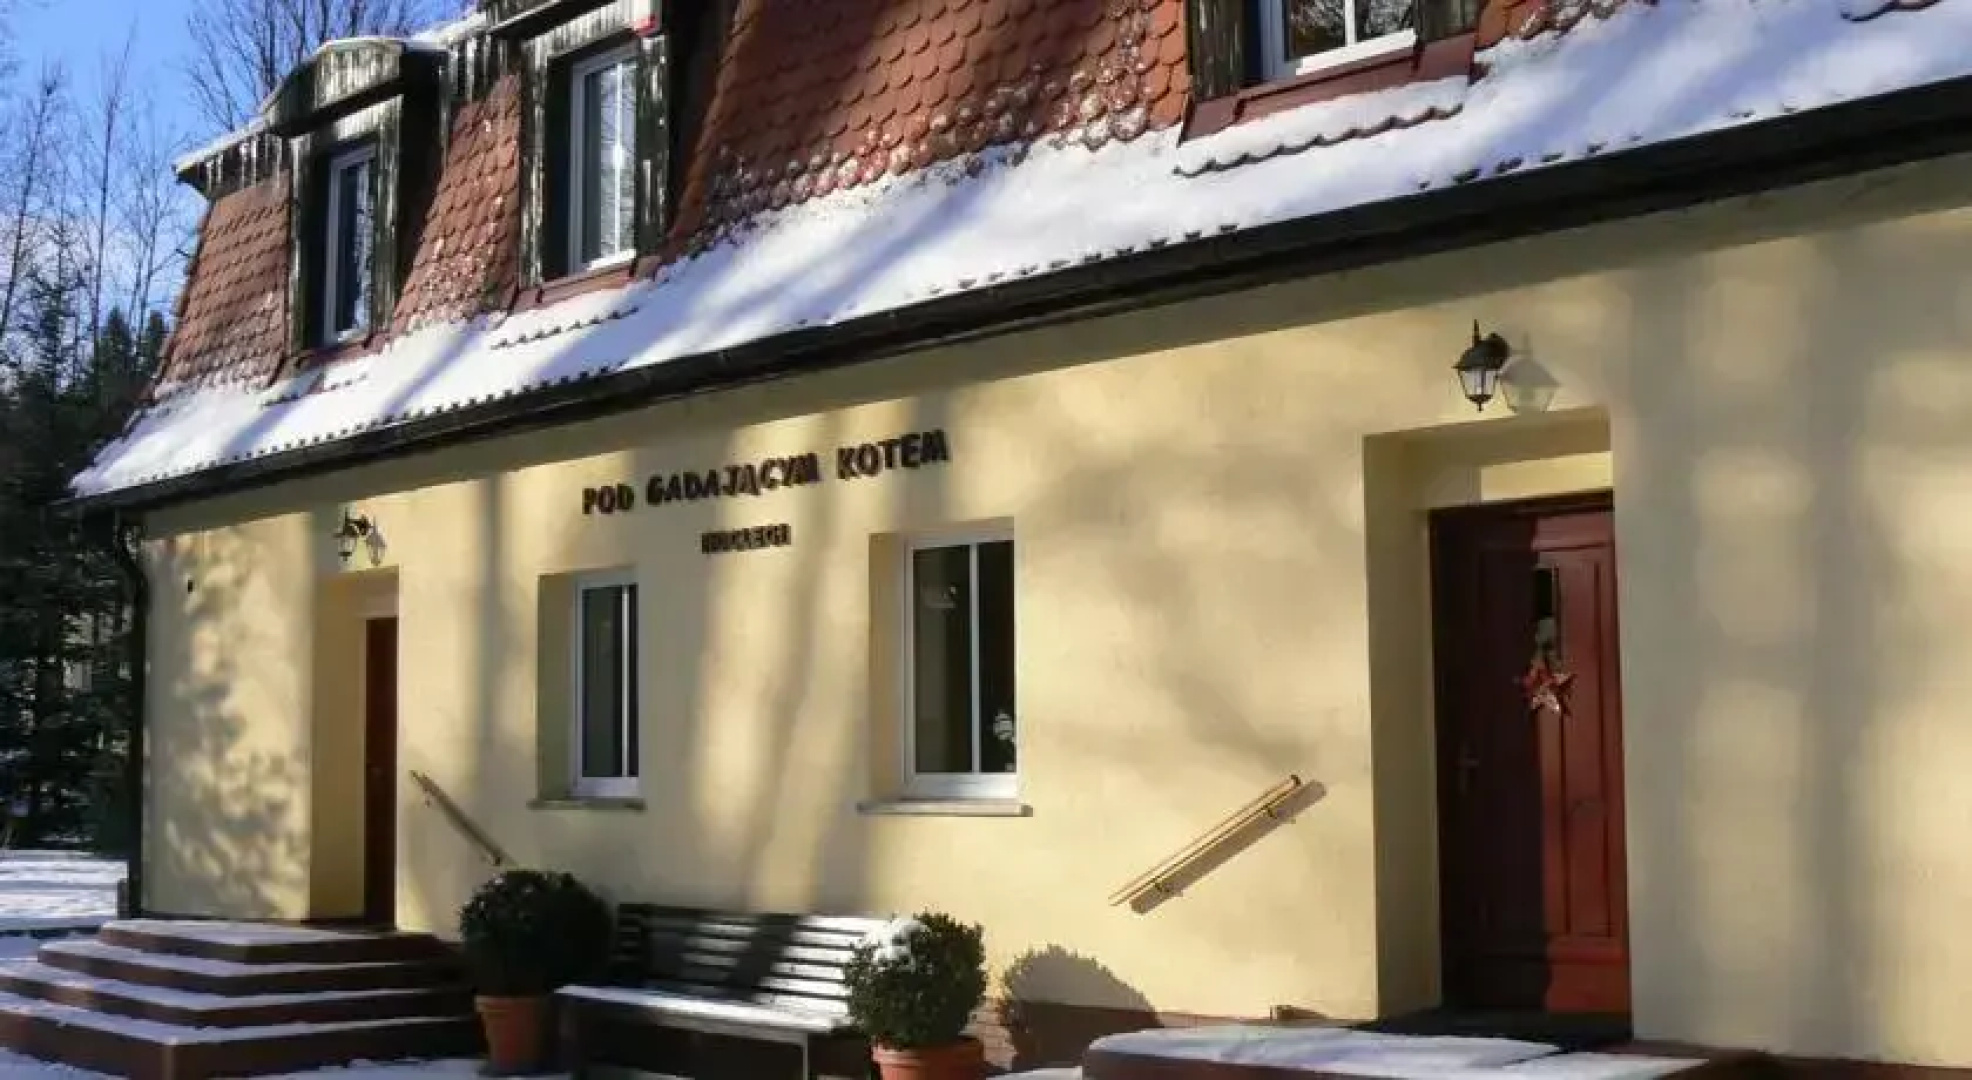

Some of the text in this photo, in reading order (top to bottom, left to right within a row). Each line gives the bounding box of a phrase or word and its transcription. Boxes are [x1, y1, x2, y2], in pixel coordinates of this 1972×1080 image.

[582, 429, 949, 515] POD GADAJĄCYM KOTEM
